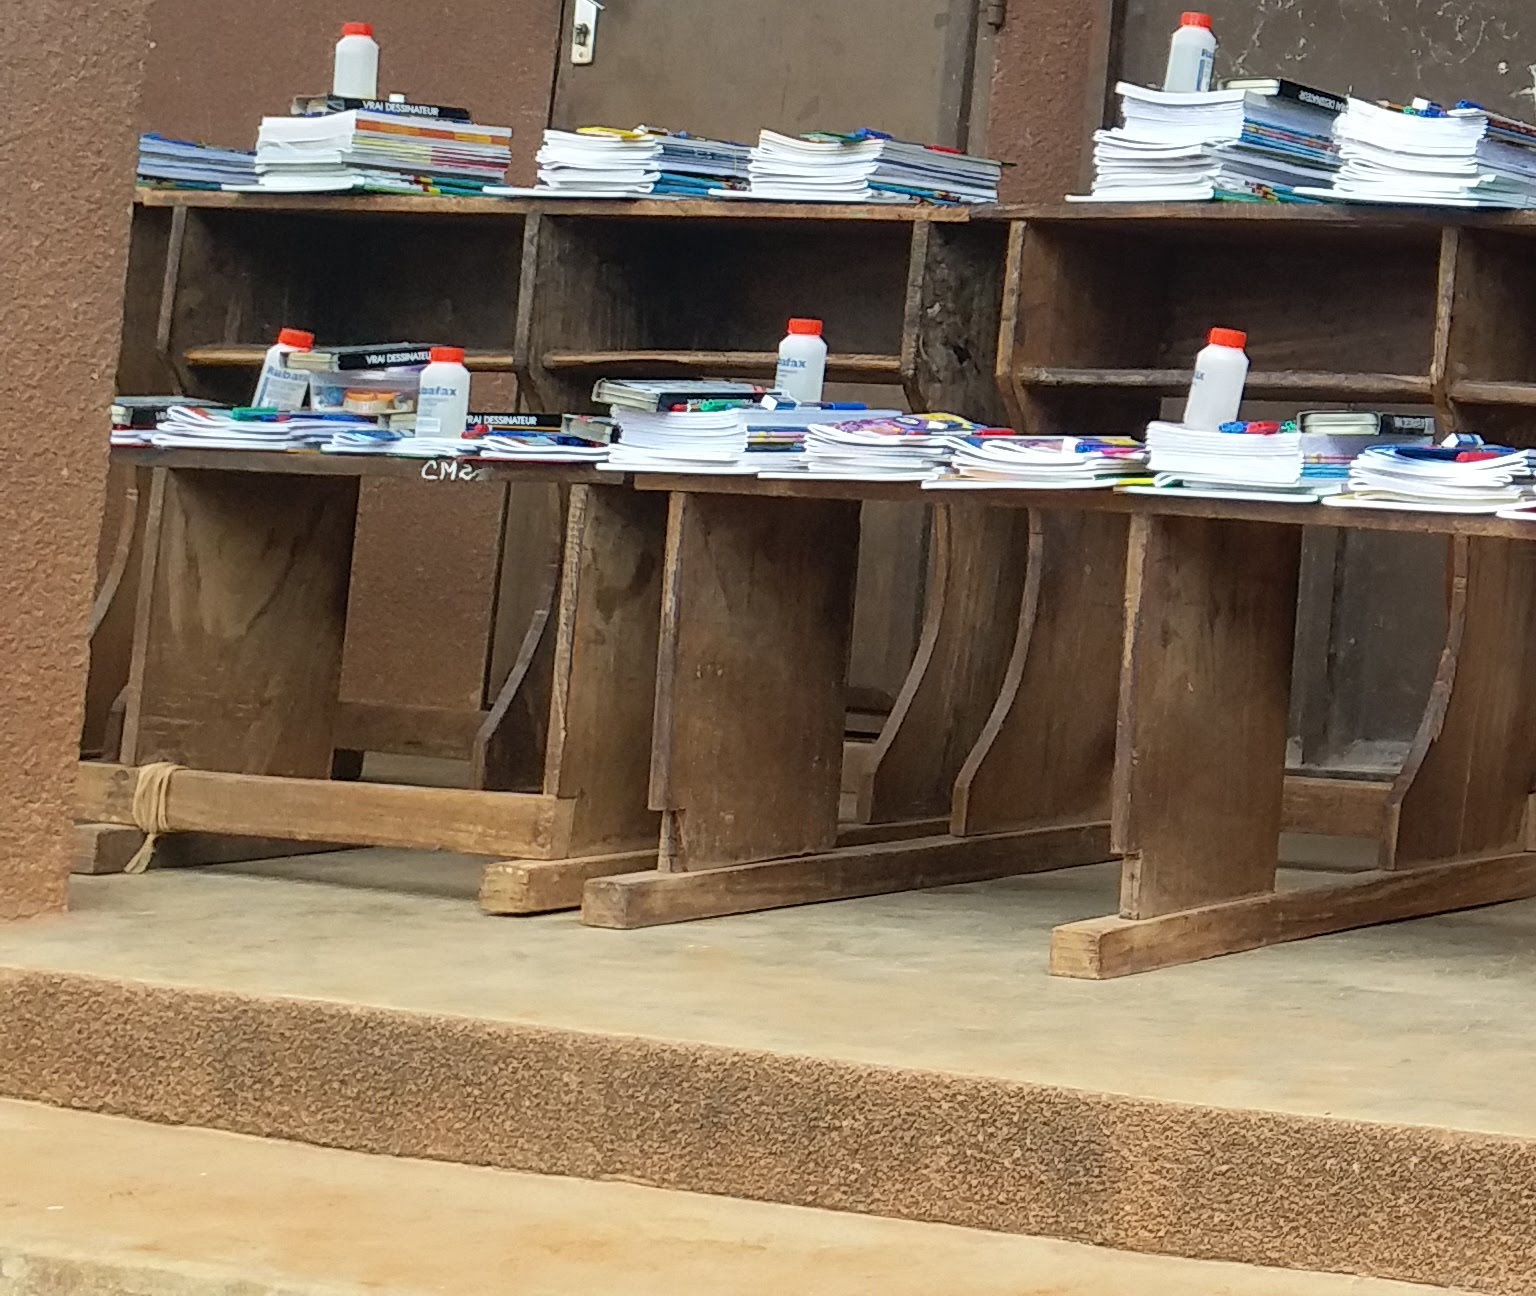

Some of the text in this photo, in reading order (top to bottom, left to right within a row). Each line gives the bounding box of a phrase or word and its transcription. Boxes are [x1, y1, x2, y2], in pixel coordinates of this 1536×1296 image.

[362, 101, 384, 111] VRAI
[365, 351, 432, 365] VRAI DESSINATEU
[484, 415, 538, 426] DESSINATEUR
